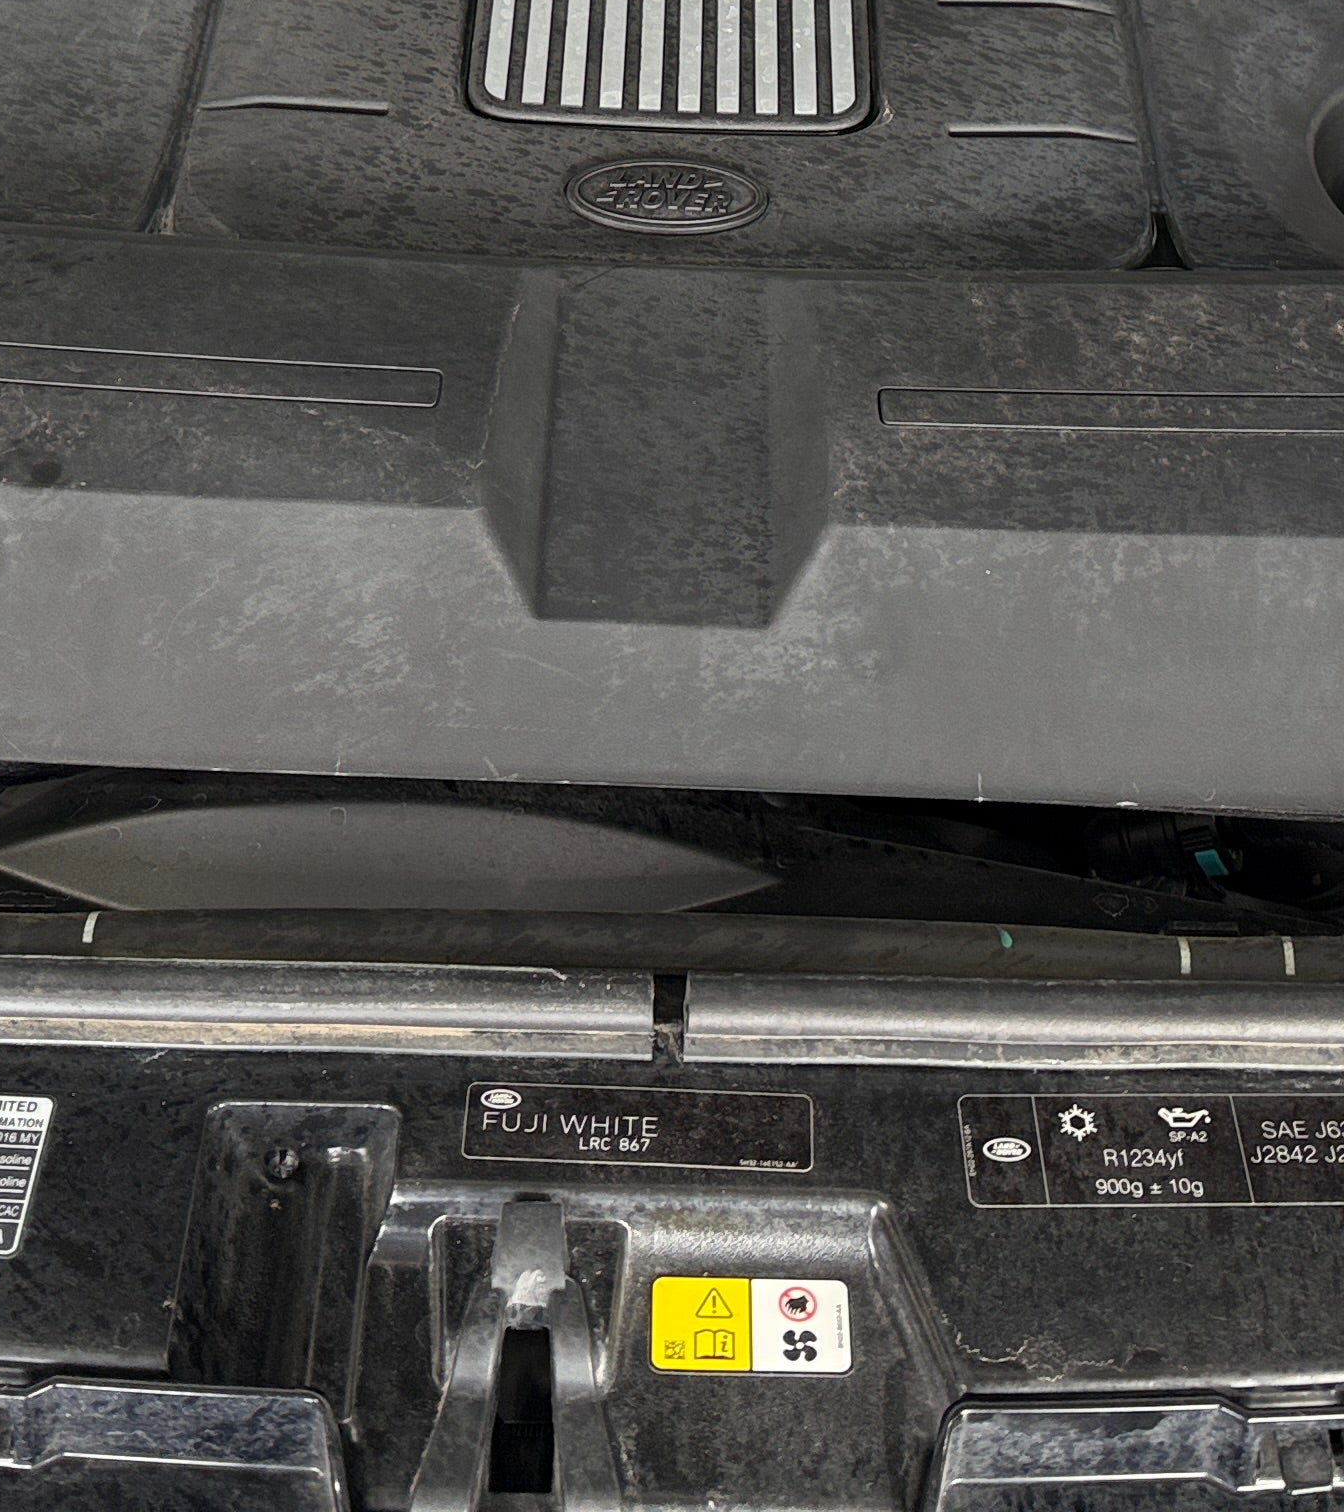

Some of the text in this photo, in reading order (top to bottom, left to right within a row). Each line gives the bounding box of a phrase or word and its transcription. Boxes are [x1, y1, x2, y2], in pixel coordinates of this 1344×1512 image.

[609, 171, 705, 190] LAND
[616, 189, 733, 213] ROVER
[482, 1111, 659, 1138] FUJI WHITE
[1260, 1120, 1310, 1140] SAE
[19, 1133, 40, 1144] MY
[578, 1137, 651, 1152] LRC 867
[1168, 1130, 1208, 1143] SP-A2
[1102, 1147, 1186, 1171] R1234yf
[1250, 1144, 1319, 1164] J2842
[1095, 1178, 1144, 1198] 900g
[1169, 1177, 1205, 1198] 10g
